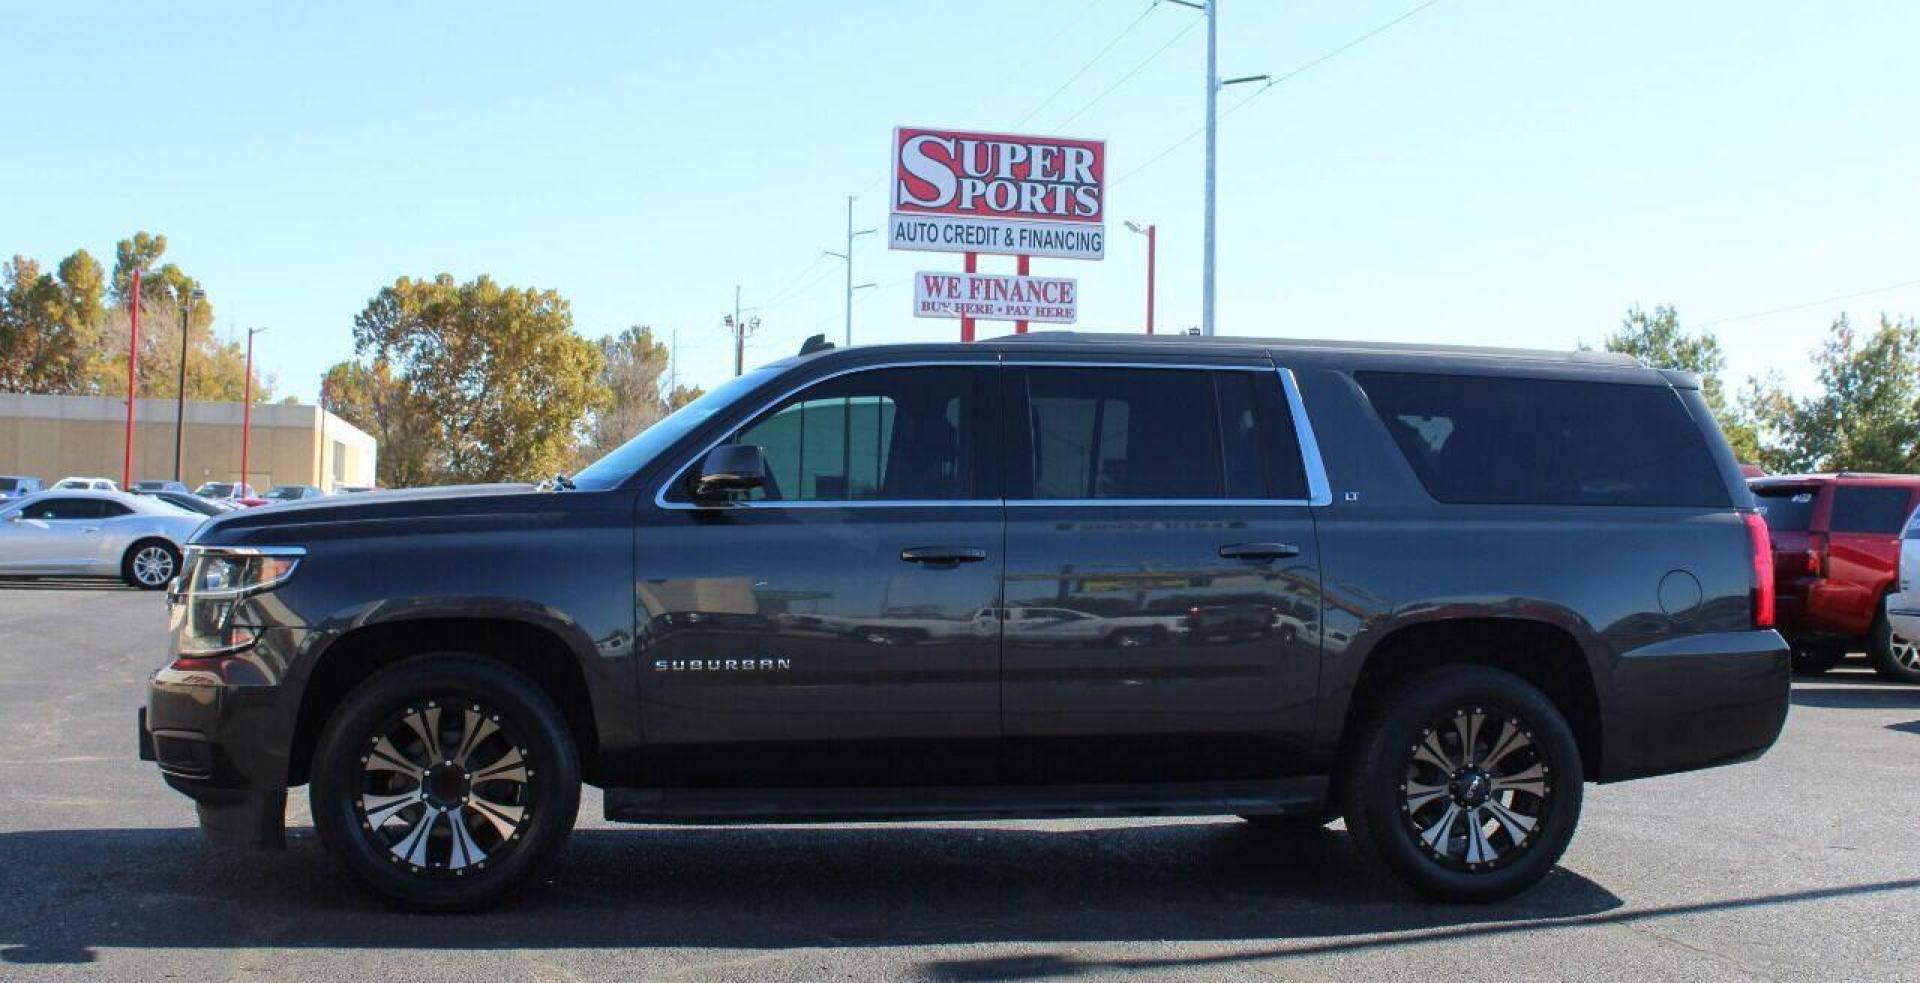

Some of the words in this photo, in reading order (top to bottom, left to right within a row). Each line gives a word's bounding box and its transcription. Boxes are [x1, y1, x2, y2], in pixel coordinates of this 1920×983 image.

[900, 134, 1098, 208] SUPER
[895, 222, 938, 243] AUTO
[943, 224, 999, 246] CREDIT
[1004, 228, 1014, 247] &
[1019, 229, 1102, 251] FINANCING
[923, 275, 961, 299] WE
[968, 278, 1074, 304] FINANCE
[921, 302, 951, 313] BUY
[955, 303, 993, 315] HERE
[1005, 304, 1031, 316] PAY
[1036, 307, 1074, 319] HERE
[1345, 491, 1360, 501] LT
[655, 659, 790, 671] SUBURBAN
